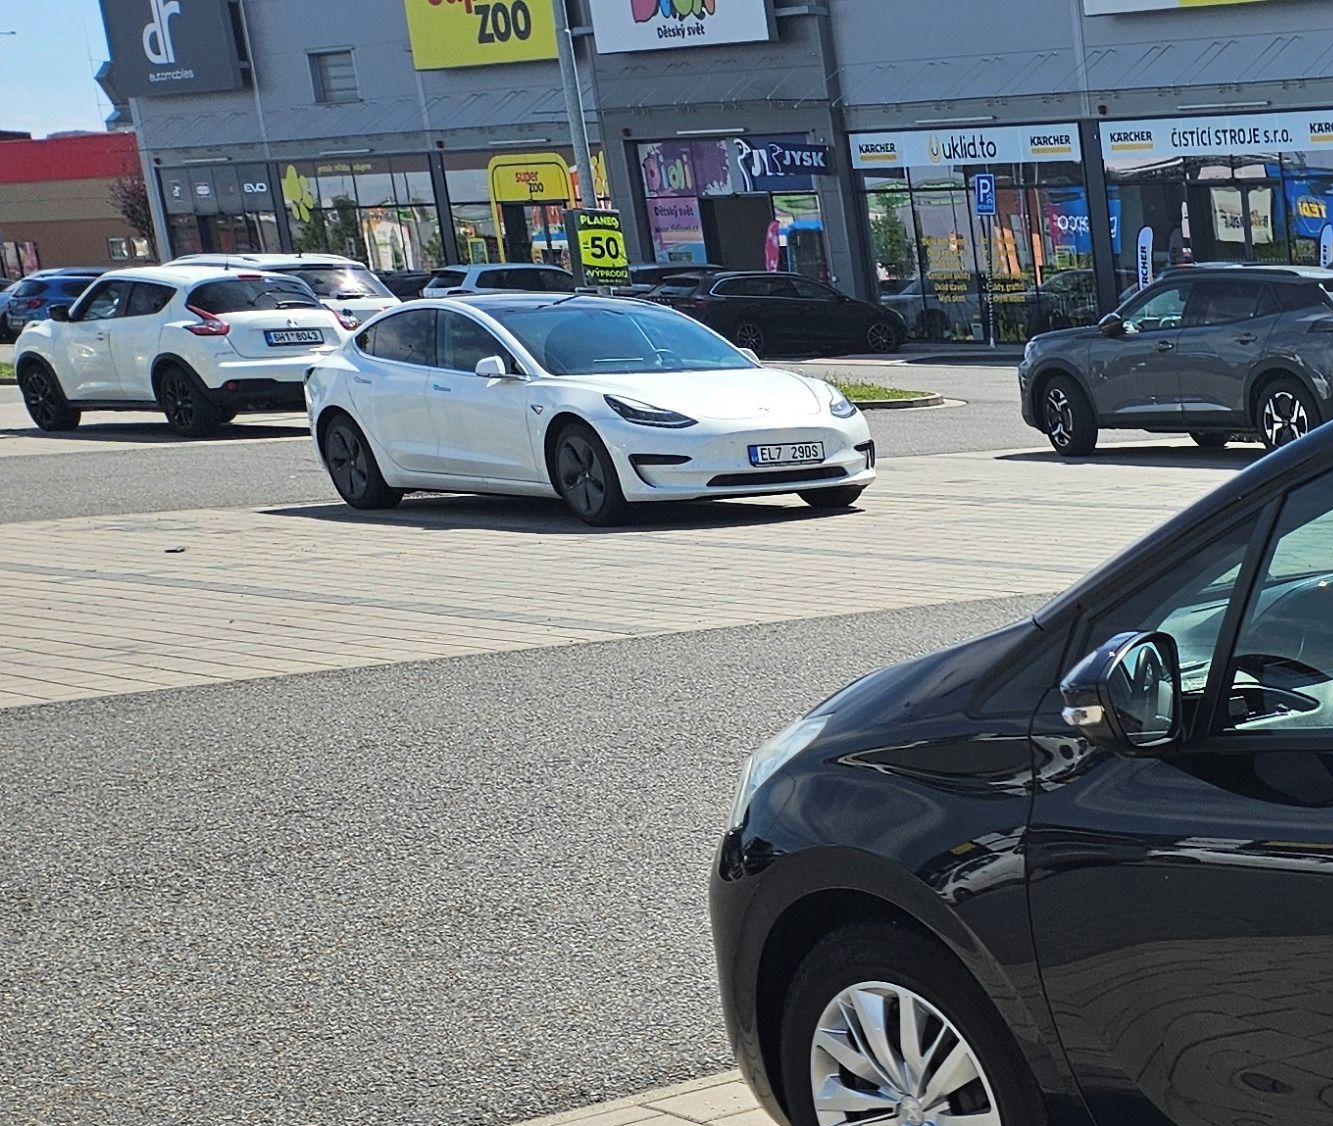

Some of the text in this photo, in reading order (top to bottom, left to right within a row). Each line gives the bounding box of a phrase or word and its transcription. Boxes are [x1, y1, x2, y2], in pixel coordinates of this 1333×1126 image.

[474, 0, 531, 43] ZOO
[657, 22, 705, 39] Dětský svět
[149, 68, 194, 82] automobiles
[1171, 127, 1293, 148] ČISTÍCÍ STROJE s.r.o.
[942, 134, 997, 159] uklid.to
[782, 151, 826, 168] JYSK
[515, 171, 539, 183] super
[244, 183, 267, 193] EVO
[980, 179, 990, 202] P
[760, 444, 819, 461] EL7 29DS
